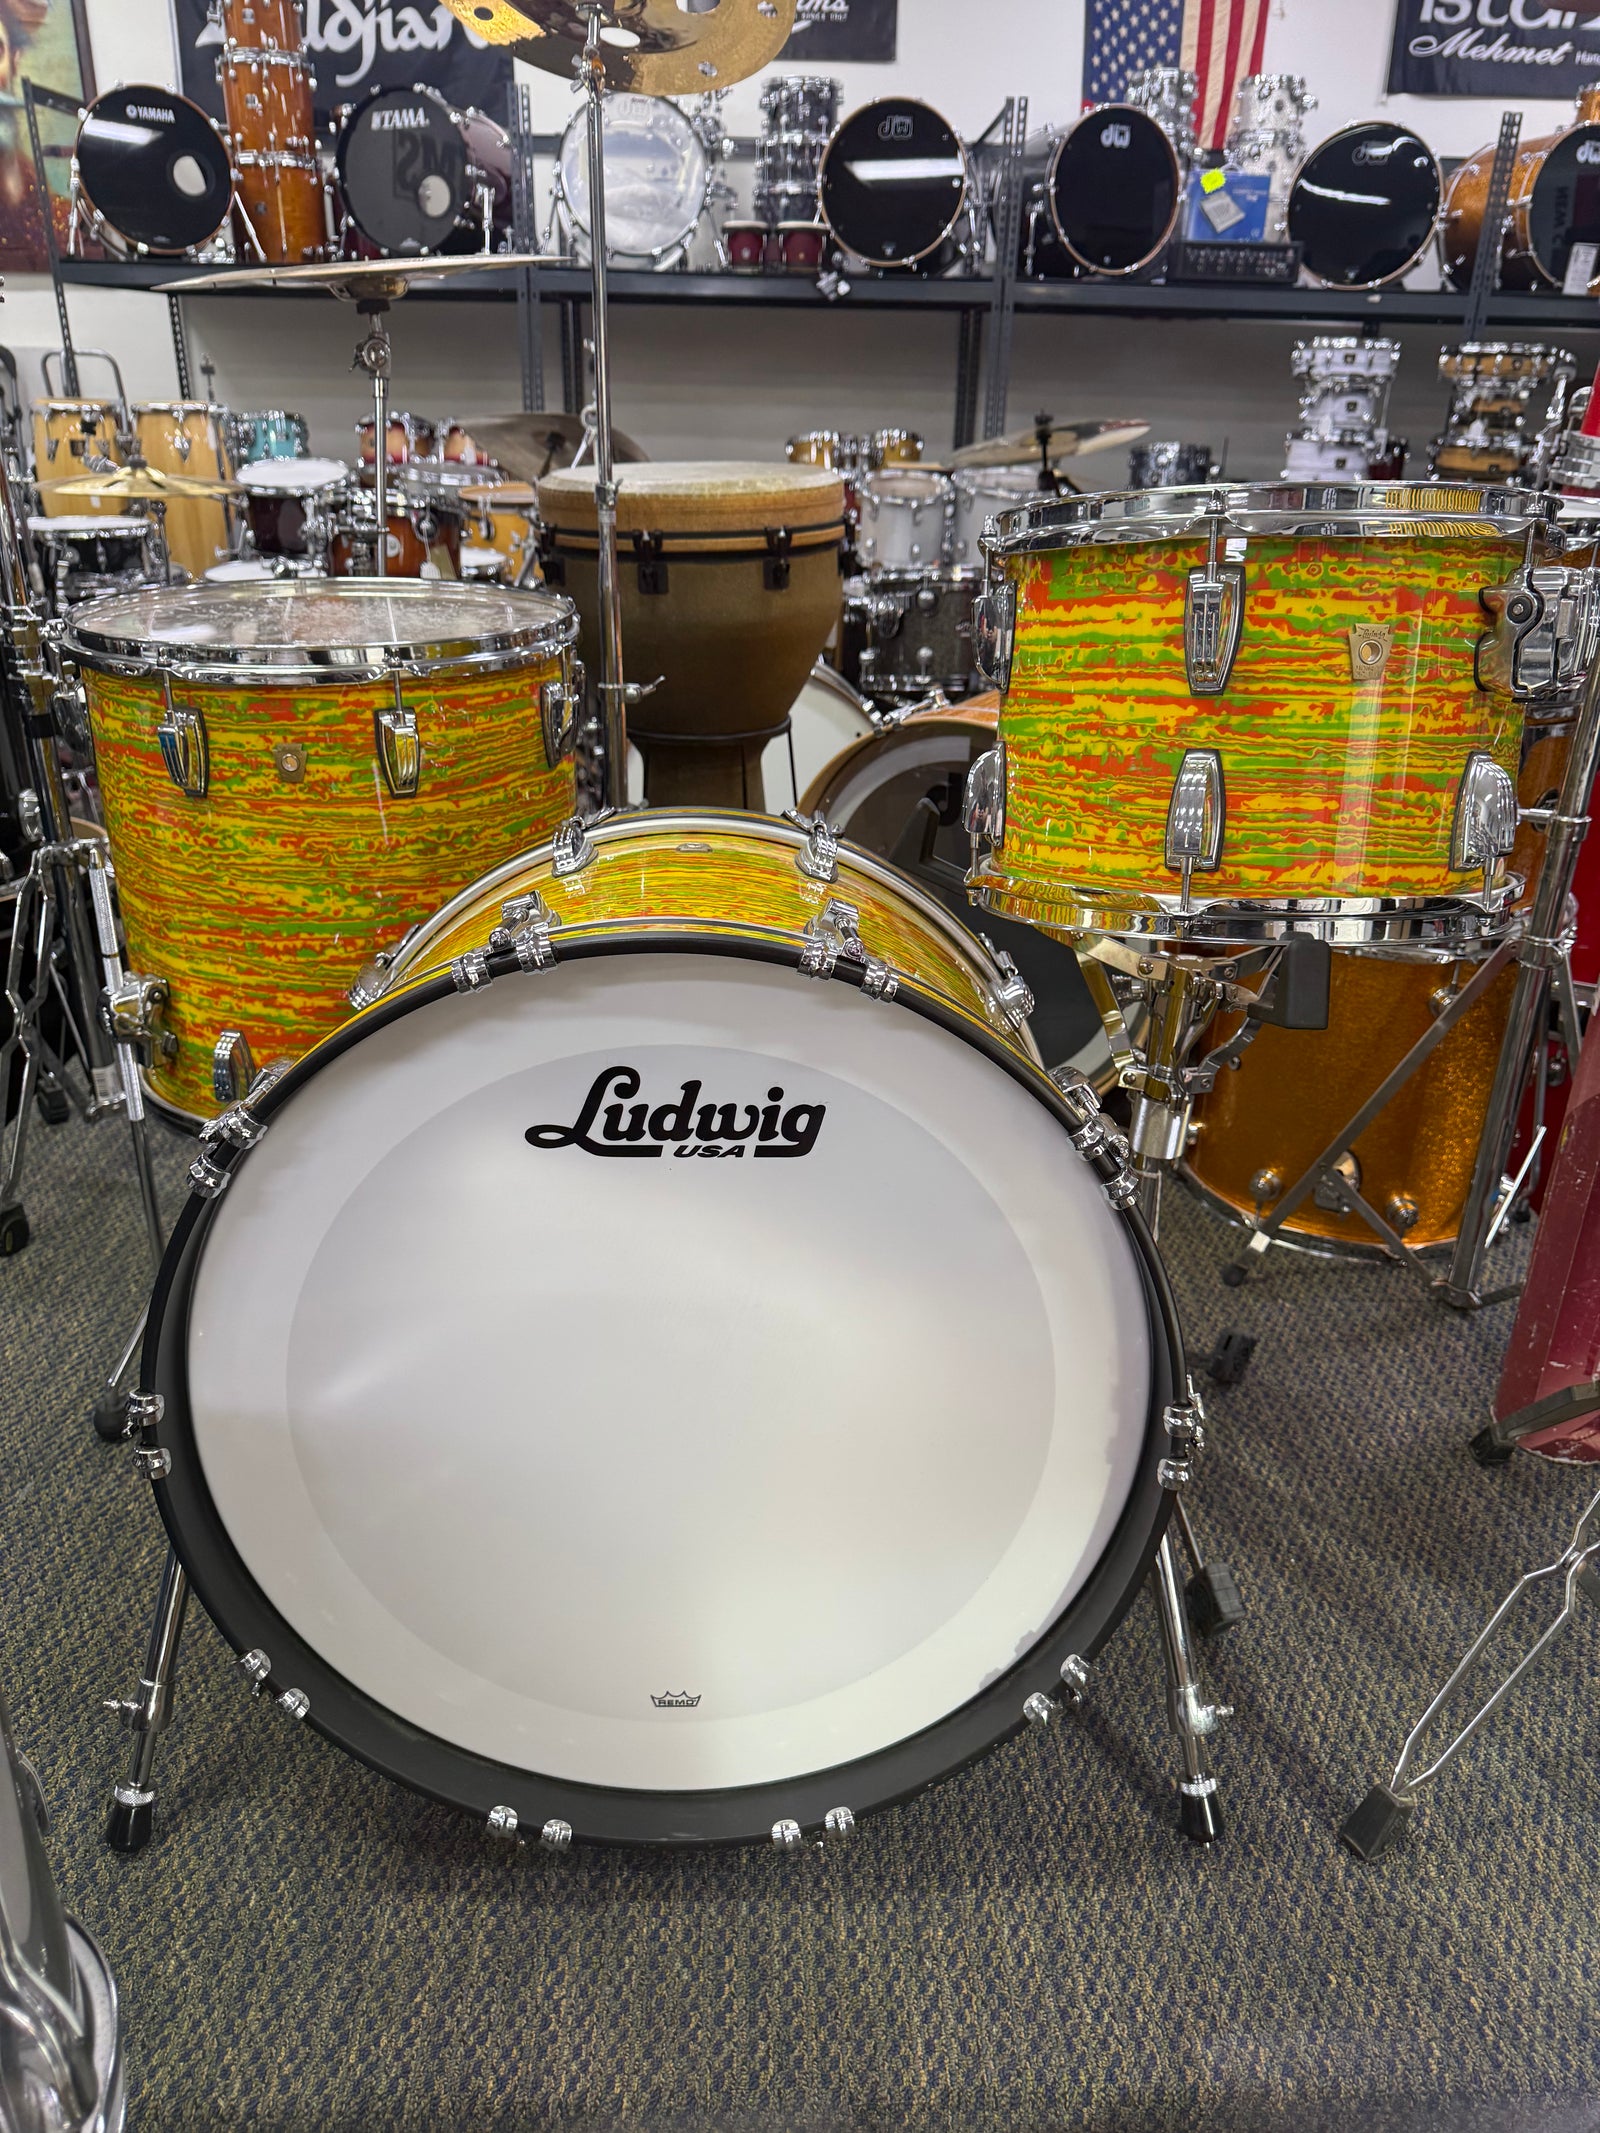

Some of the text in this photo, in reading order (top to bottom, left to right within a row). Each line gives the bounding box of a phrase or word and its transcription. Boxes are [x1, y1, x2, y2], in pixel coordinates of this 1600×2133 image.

[1408, 27, 1574, 66] Mehmet
[137, 105, 176, 124] YAMAHA
[383, 107, 426, 130] TAMA
[525, 1065, 826, 1158] Ludwig
[673, 1145, 745, 1158] USA
[658, 1699, 695, 1707] REMO
